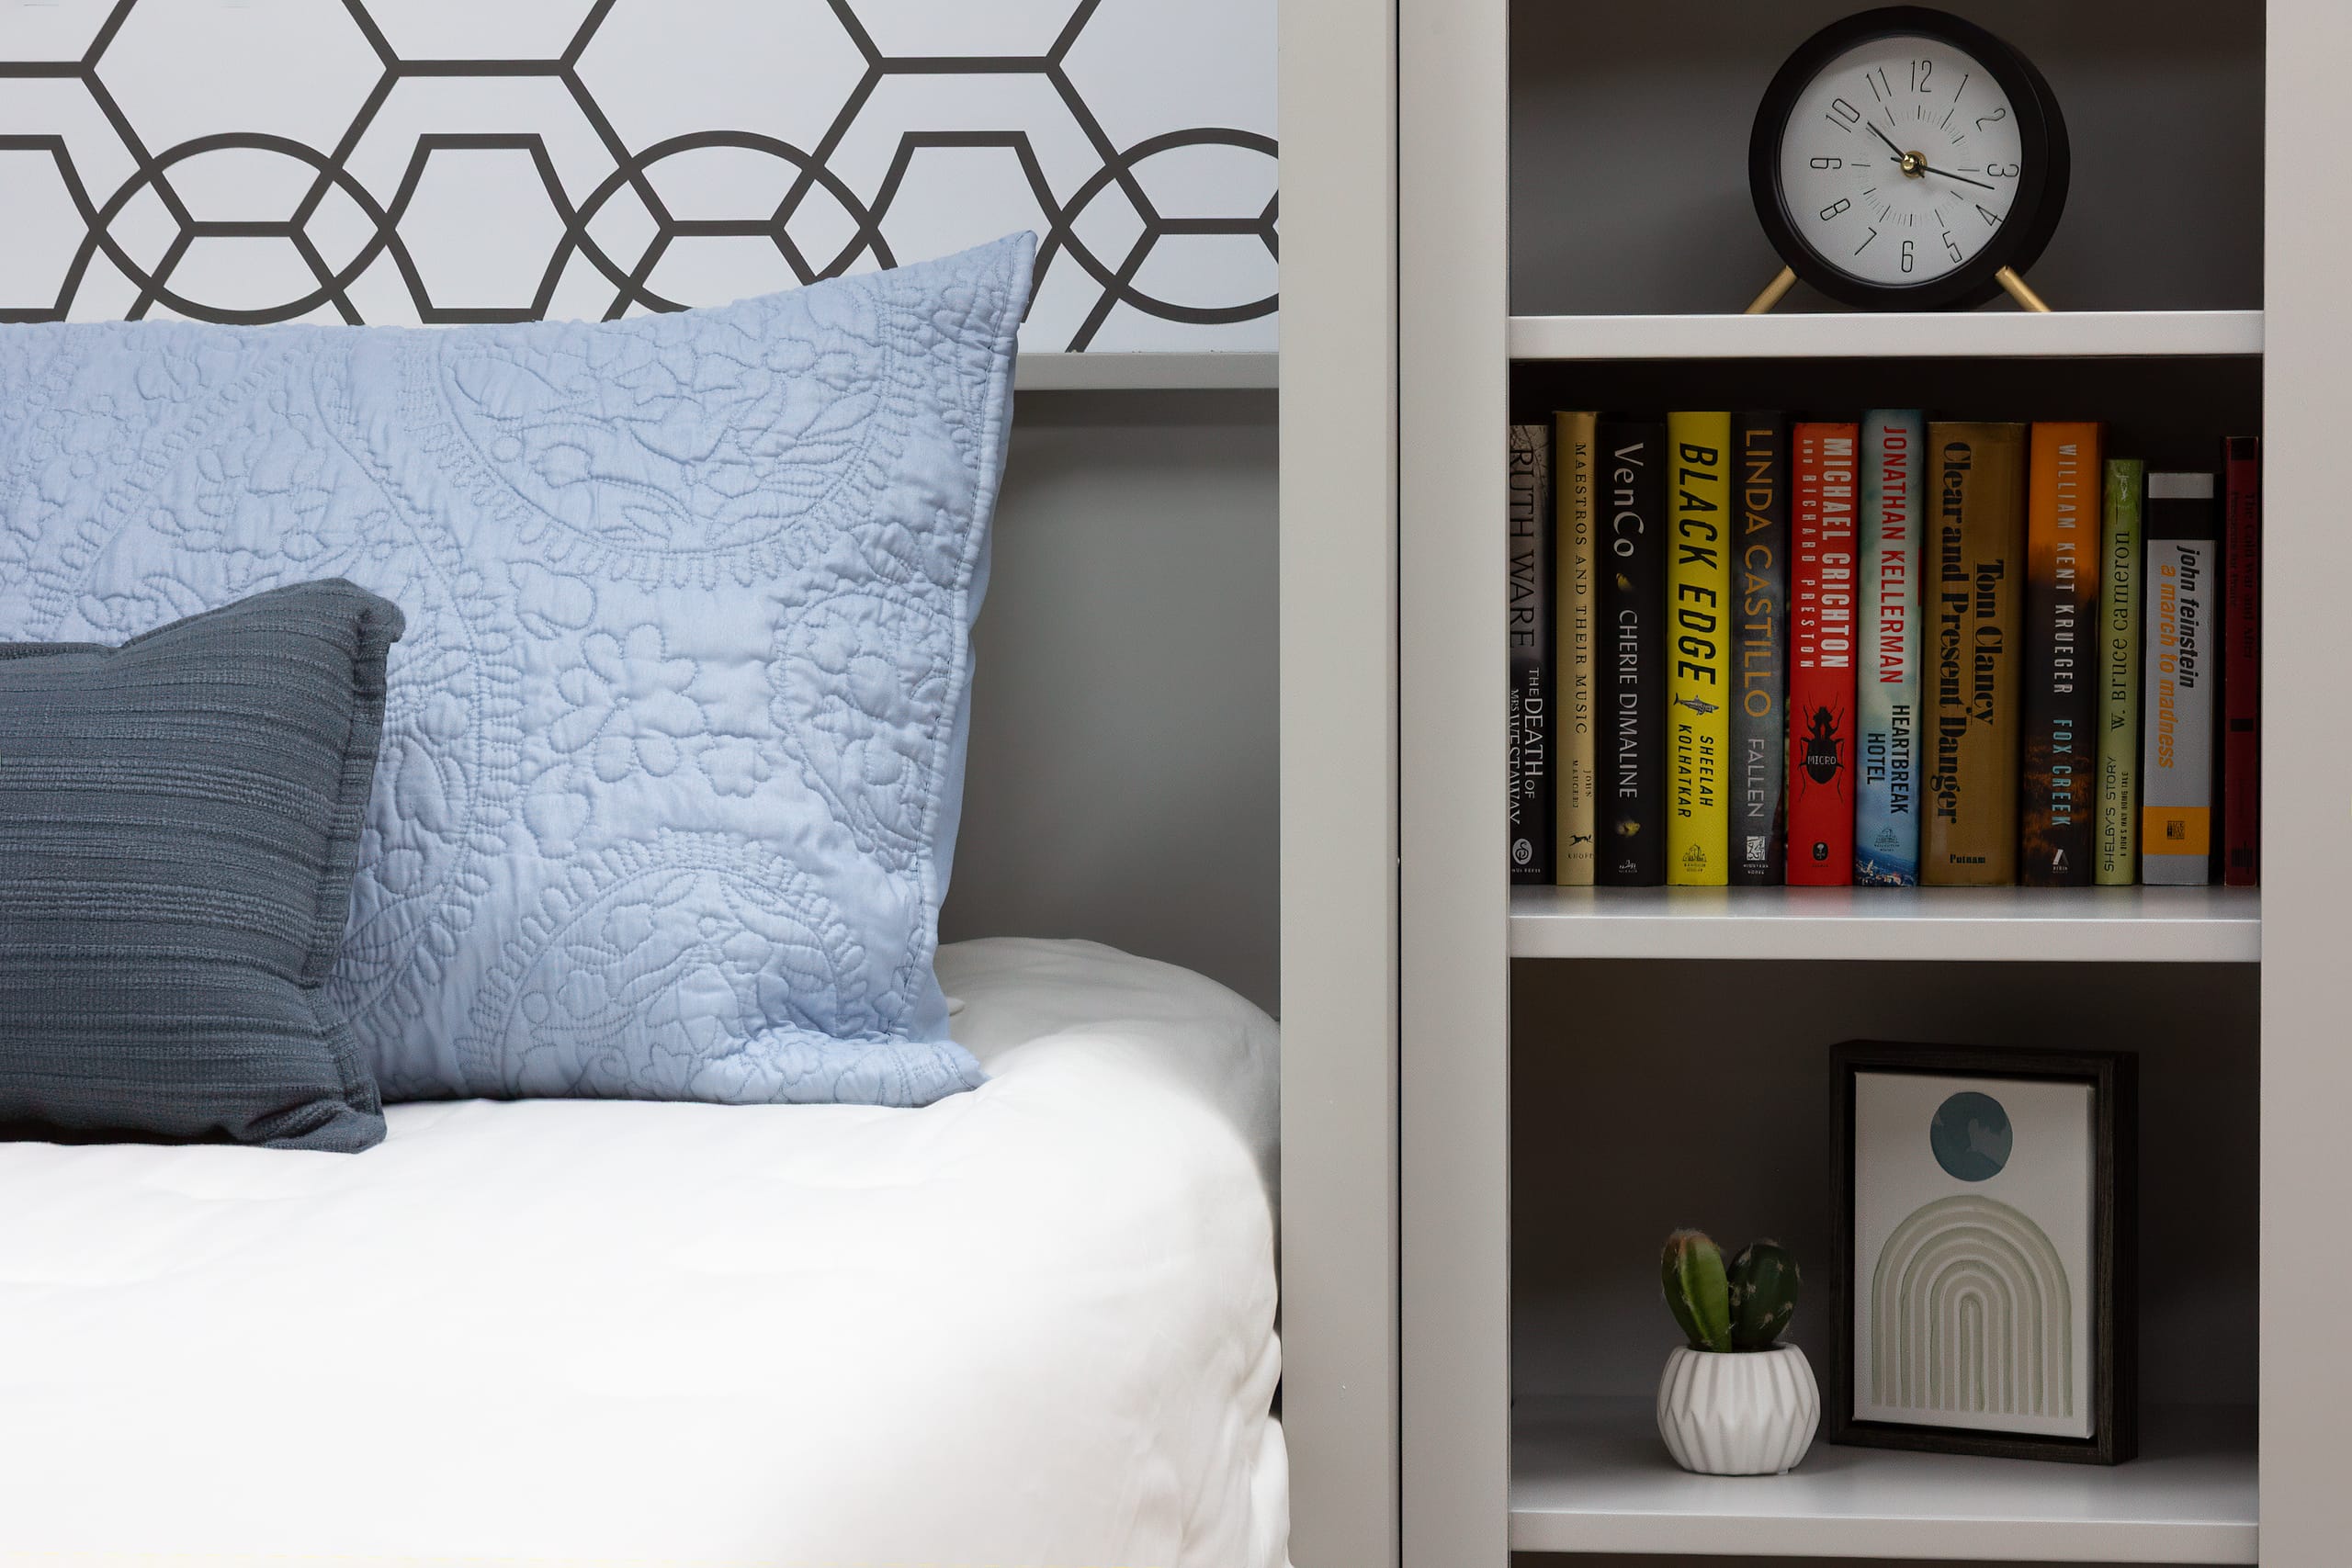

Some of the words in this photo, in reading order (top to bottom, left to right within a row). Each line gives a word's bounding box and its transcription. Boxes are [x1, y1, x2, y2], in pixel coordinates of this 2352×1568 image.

[1866, 67, 1892, 103] 11
[1910, 60, 1932, 93] 12
[1954, 73, 1969, 103] 1
[1825, 98, 1860, 133] 10
[1975, 107, 2006, 131] 2
[1809, 157, 1842, 170] 9
[1986, 164, 2019, 177] 3
[1820, 197, 1850, 221] 8
[1854, 227, 1877, 255] 7
[1975, 204, 2003, 227] 4
[1901, 241, 1914, 273] 6
[1942, 231, 1962, 264] 5
[1510, 448, 1534, 537] RUTH
[1575, 443, 1588, 546] MAESTROS
[1612, 442, 1645, 558] VenCo
[1679, 442, 1718, 570] BLACK
[1746, 429, 1773, 536] LINDA
[1822, 437, 1853, 541] MICHAEL
[1881, 425, 1907, 540] JONATHAN
[1942, 442, 1972, 524] Clear
[2057, 444, 2077, 528] WILLIAM
[1802, 474, 1817, 562] RICHARD
[1575, 556, 1588, 596] AND
[1941, 526, 1970, 582] and
[2055, 542, 2076, 592] KENT
[2113, 531, 2130, 632] cameron
[2160, 565, 2176, 578] a
[2177, 545, 2200, 592] john
[1510, 549, 1534, 649] WARE
[1820, 552, 1851, 668] CRICHTON
[1880, 550, 1905, 684] KELLERMAN
[1975, 558, 2005, 618] Tom
[2160, 583, 2179, 648] march
[1575, 605, 1588, 665] THEIR
[1619, 609, 1638, 684] CHERIE
[1678, 583, 1717, 686] EDGE
[1745, 544, 1772, 718] CASTILLO
[1800, 579, 1815, 668] PRESTON
[1939, 592, 1969, 708] Present
[2053, 604, 2075, 694] KRUEGER
[2179, 597, 2199, 689] feinstein
[1528, 667, 1540, 696] THE
[1965, 626, 2004, 726] Clancy
[2159, 653, 2178, 673] to
[1524, 697, 1544, 777] DEATH
[1575, 675, 1588, 735] MUSIC
[2052, 719, 2073, 754] FOX
[2159, 679, 2178, 769] madness
[1619, 693, 1638, 799] DIMALINE
[1678, 724, 1692, 818] KOLHATKAR
[1700, 735, 1714, 807] SHEELAH
[1747, 739, 1765, 818] FALLEN
[1807, 755, 1837, 766] MICRO
[1866, 733, 1886, 785] HOTEL
[1890, 705, 1910, 815] HEARTBREAK
[1930, 716, 1968, 824] Danger
[2106, 756, 2118, 802] STORY
[1524, 779, 1535, 799] OF
[2051, 765, 2072, 826] CREEK
[1949, 853, 1986, 864] Putnam
[2104, 807, 2116, 873] SHELBY'S
